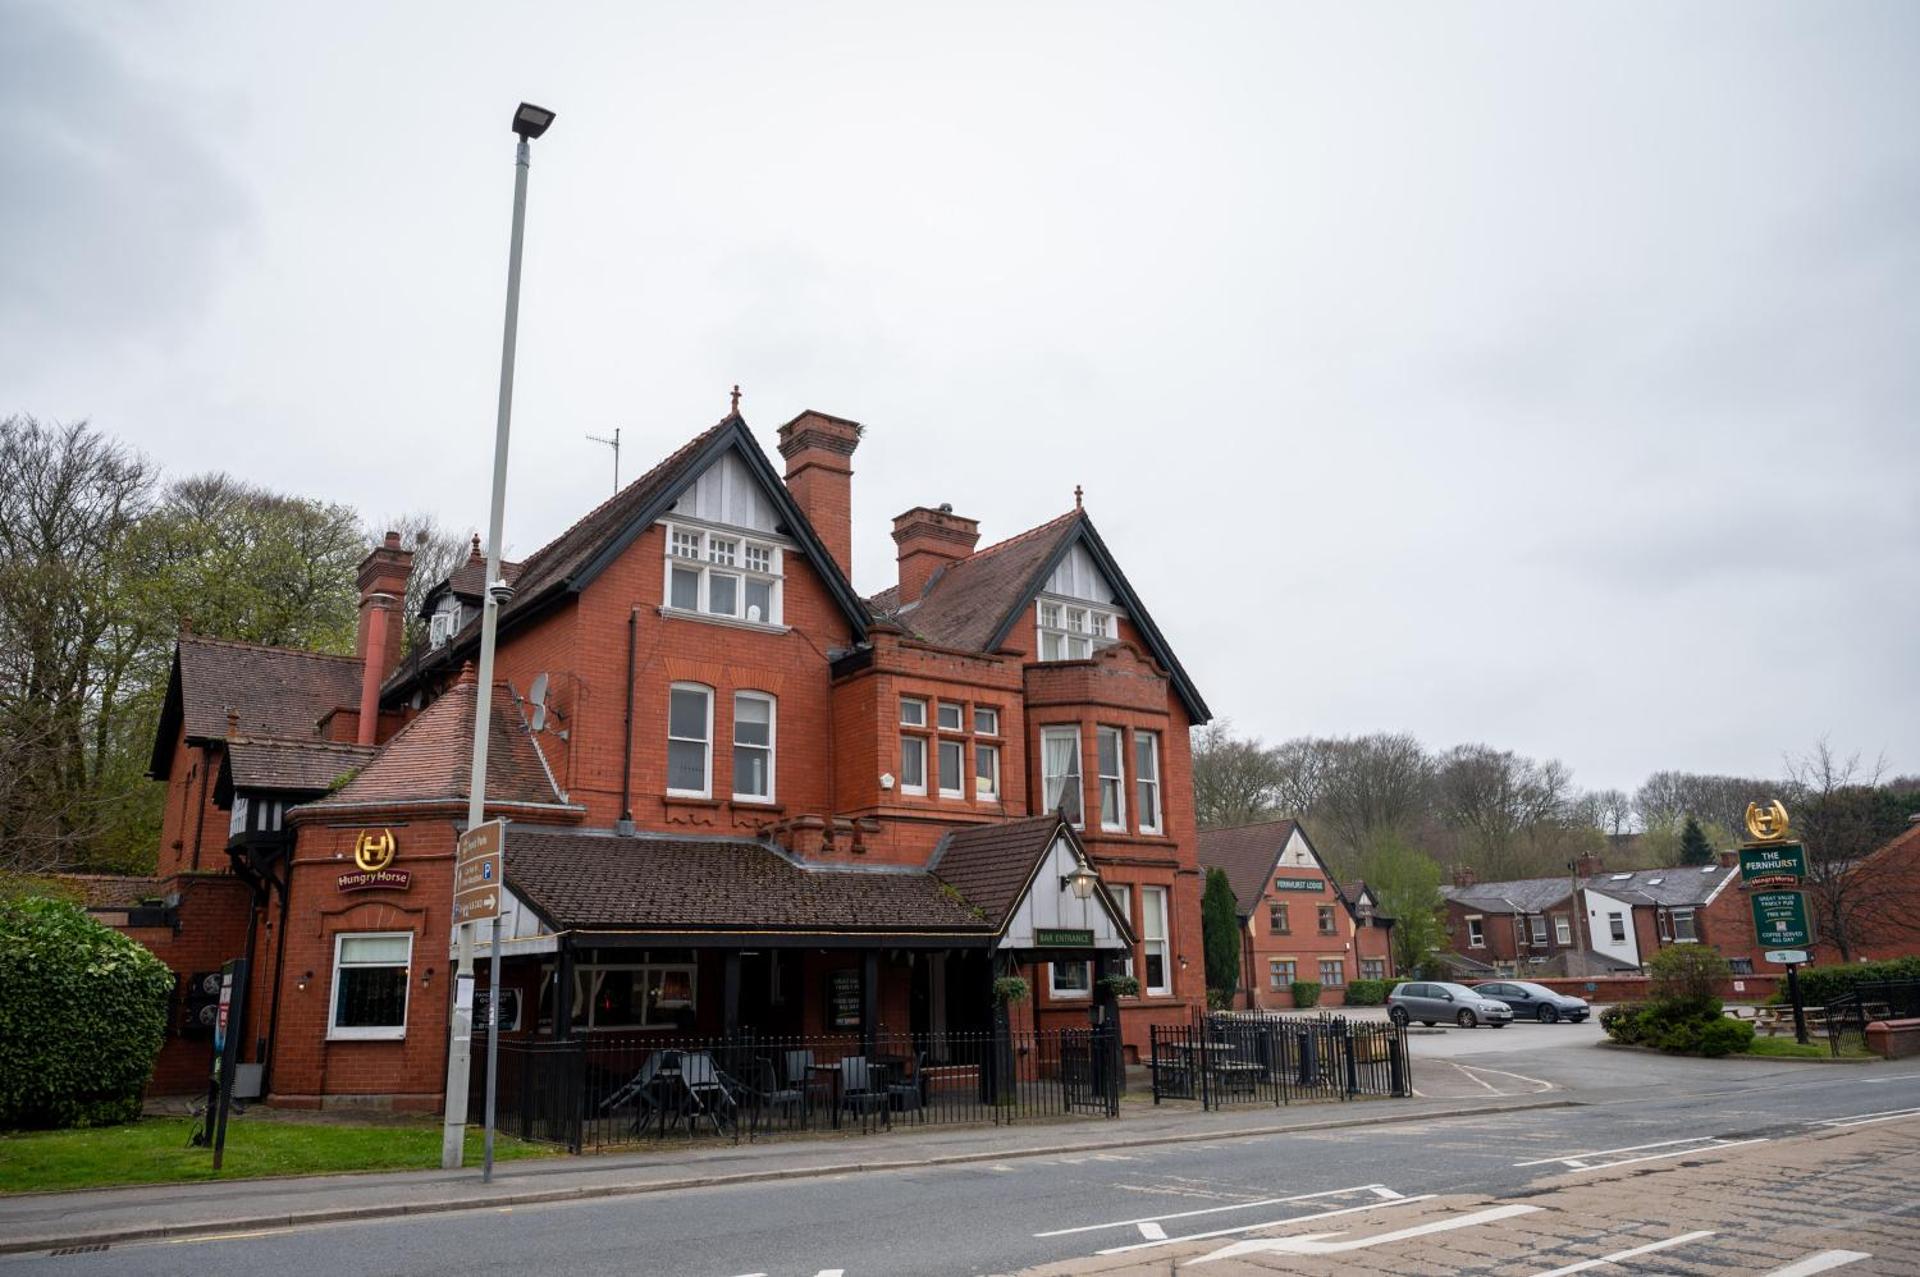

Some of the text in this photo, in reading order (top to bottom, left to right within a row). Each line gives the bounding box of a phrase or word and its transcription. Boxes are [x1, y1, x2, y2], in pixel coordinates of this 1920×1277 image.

[1761, 851, 1780, 860] THE
[1746, 859, 1797, 870] FERNHURST
[338, 871, 407, 886] Hungry Horse
[1055, 934, 1090, 943] ENTRANCE
